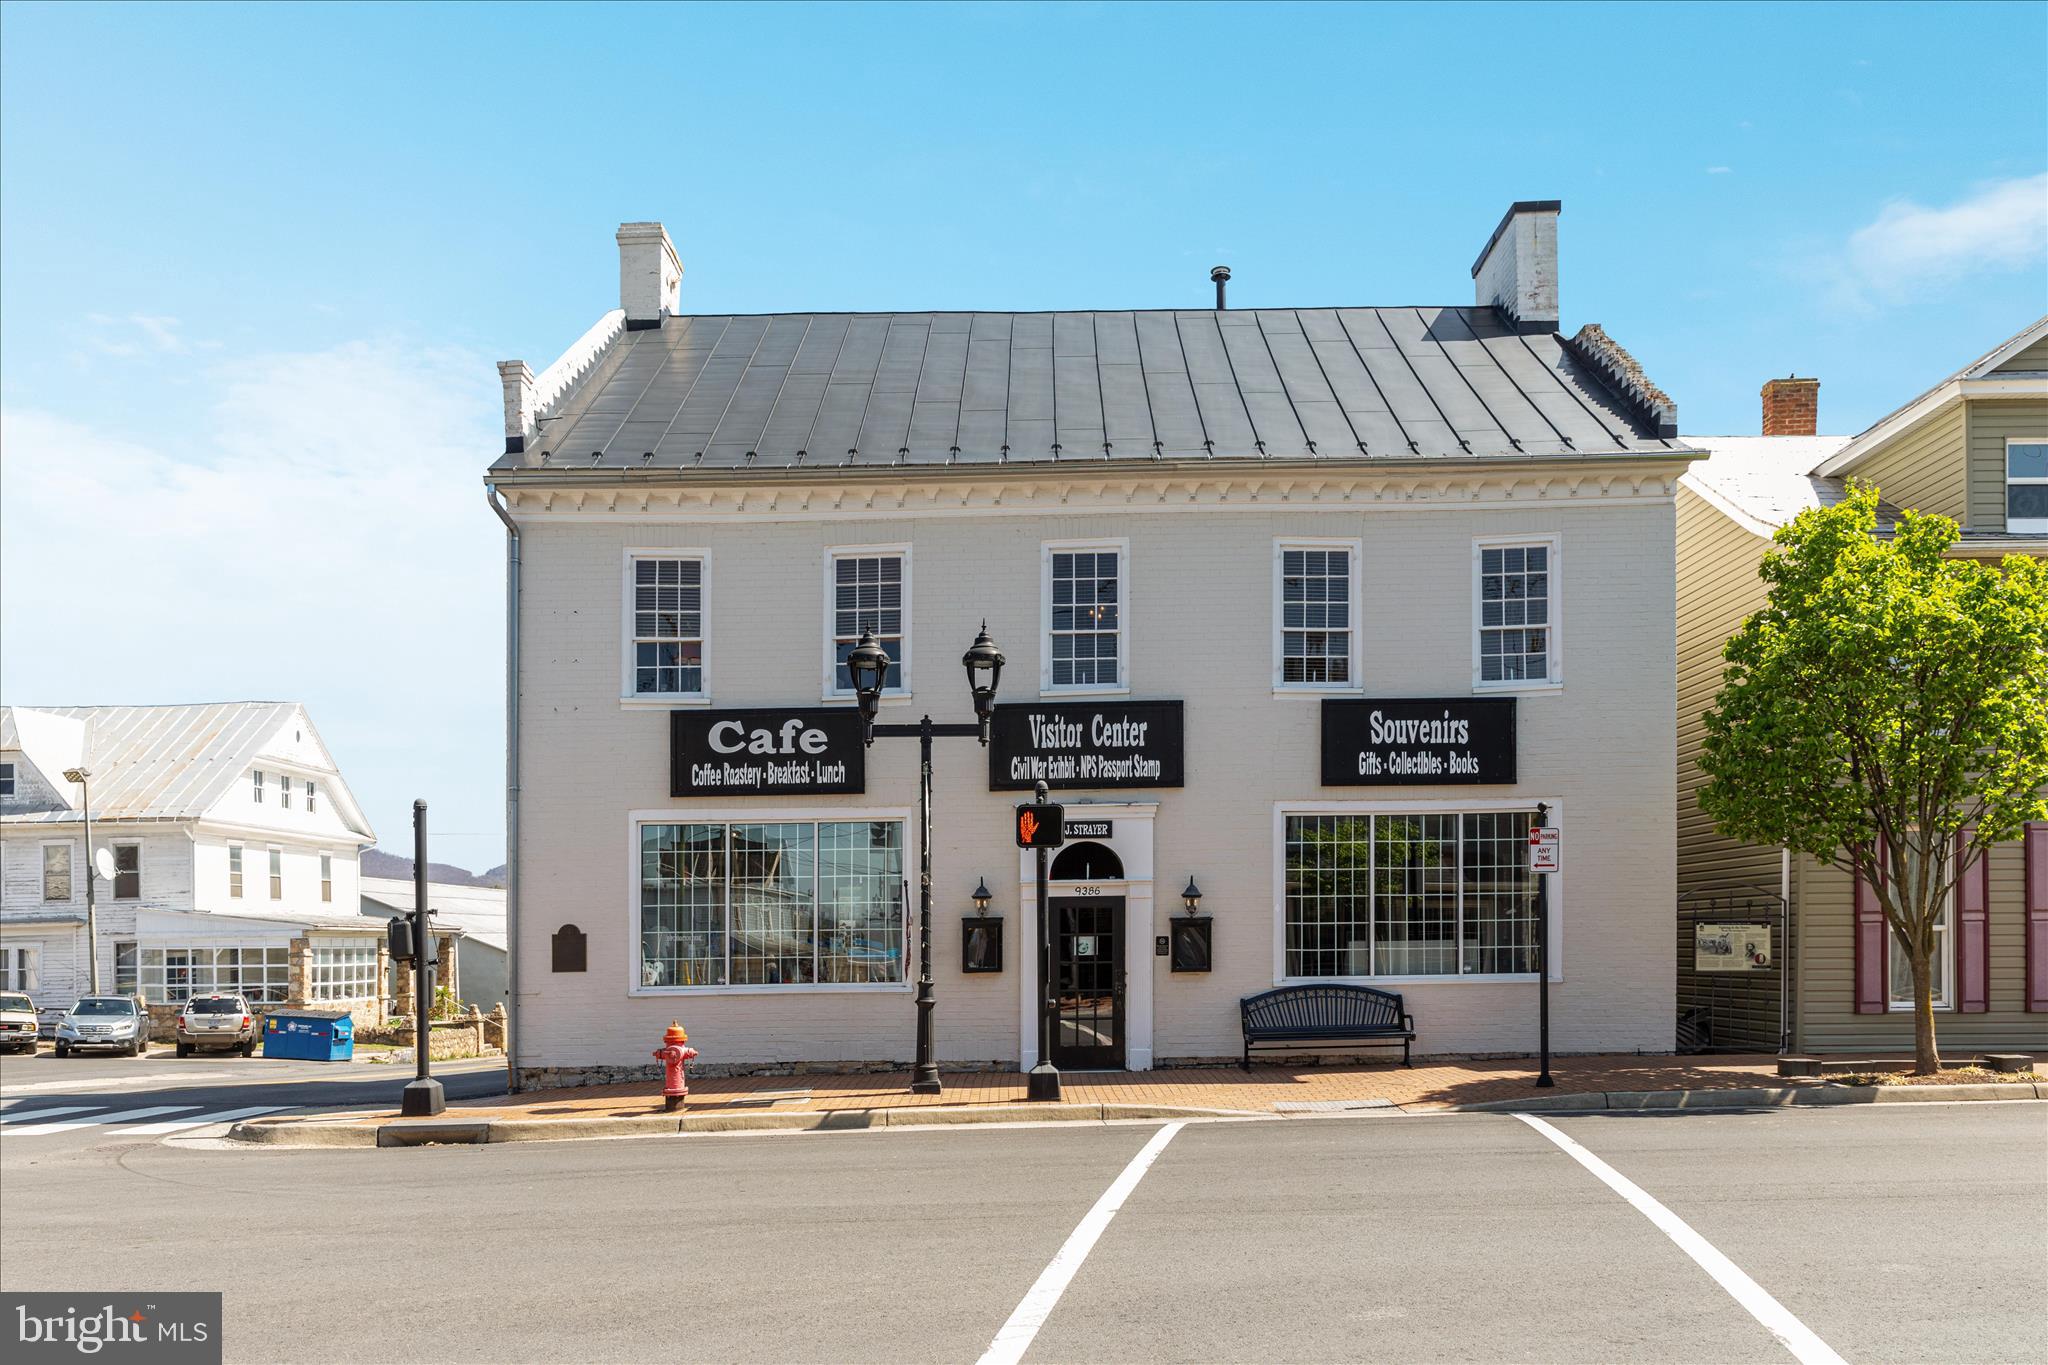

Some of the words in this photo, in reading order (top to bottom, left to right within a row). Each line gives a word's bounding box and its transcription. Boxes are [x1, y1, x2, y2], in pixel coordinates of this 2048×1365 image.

[708, 718, 829, 755] Cafe
[1028, 714, 1083, 749] Visitor
[1091, 713, 1148, 747] Center
[1369, 709, 1469, 744] Souvenirs
[691, 763, 722, 787] Coffee
[723, 762, 762, 789] Roastery
[767, 760, 810, 785] Breakfast
[816, 760, 846, 784] Lunch
[1010, 756, 1030, 781] Civil
[1030, 756, 1048, 780] War
[1080, 754, 1097, 778] NPS
[1098, 755, 1133, 781] Passport
[1133, 753, 1161, 780] Stamp
[1358, 751, 1382, 775] Gifts
[1449, 750, 1480, 774] Books
[1065, 825, 1072, 835] J.
[1073, 824, 1108, 835] STRAYER
[1530, 831, 1540, 841] NO
[1075, 886, 1101, 895] 9386
